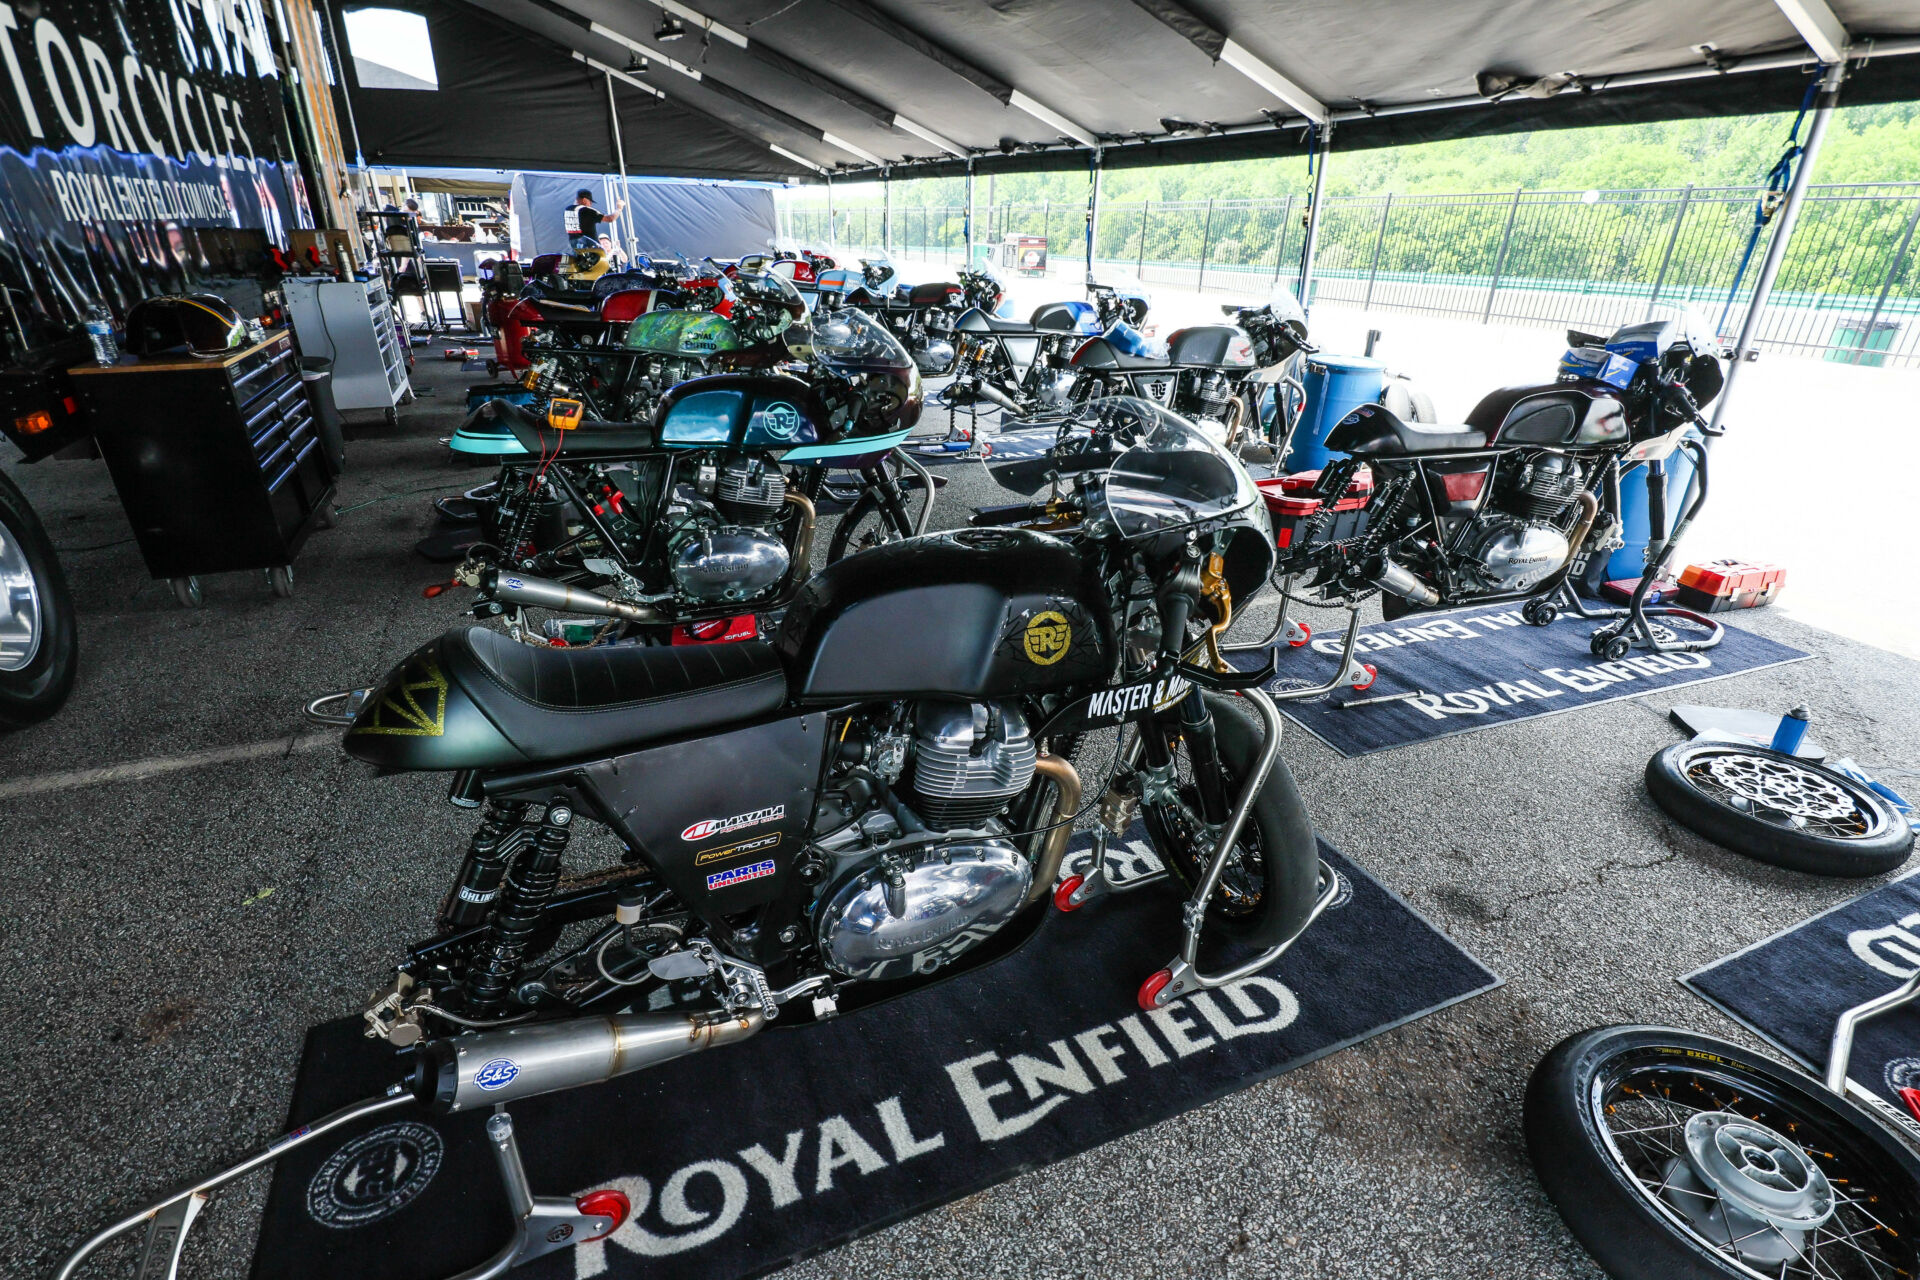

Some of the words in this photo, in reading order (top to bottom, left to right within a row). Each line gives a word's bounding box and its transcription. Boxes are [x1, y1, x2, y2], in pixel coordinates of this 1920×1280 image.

[1508, 557, 1529, 565] ROYAL
[733, 631, 752, 640] FUEL
[1402, 679, 1565, 720] ROYAL
[1538, 651, 1713, 694] ENFIELD
[1087, 684, 1152, 719] MASTER
[1152, 679, 1165, 705] &
[711, 804, 785, 831] MAXIMA
[707, 860, 775, 885] PARTS
[708, 868, 776, 890] UNLIMITED
[1686, 1049, 1725, 1064] EXCEL
[480, 1065, 515, 1084] S&S
[568, 1095, 946, 1280] ROYAL
[945, 975, 1300, 1142] ENFIELD
